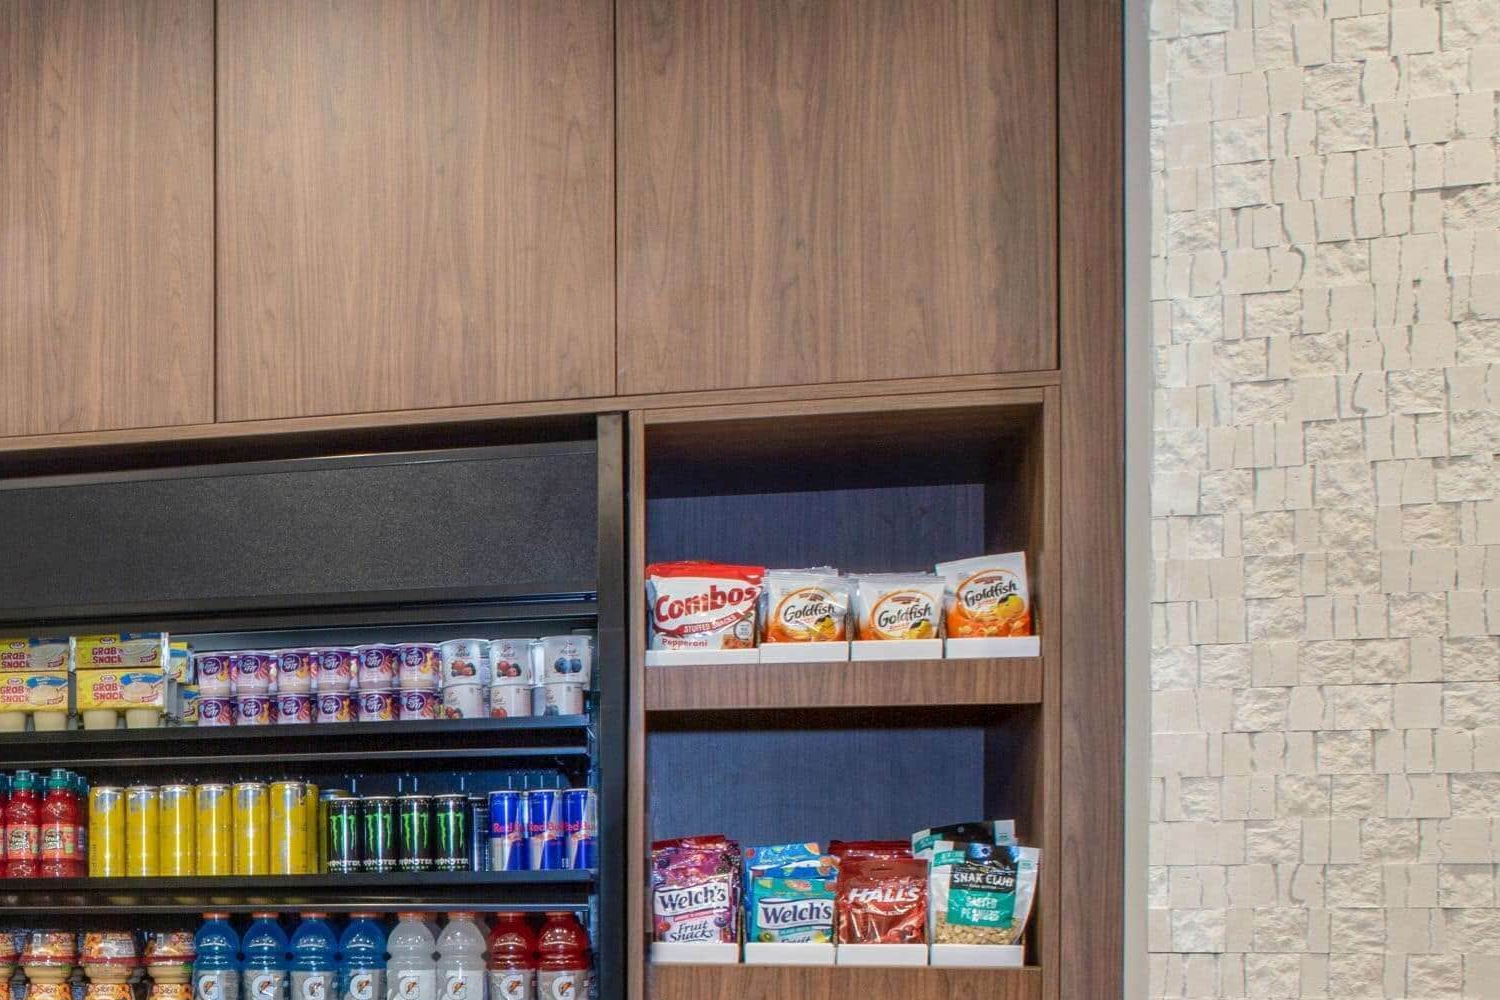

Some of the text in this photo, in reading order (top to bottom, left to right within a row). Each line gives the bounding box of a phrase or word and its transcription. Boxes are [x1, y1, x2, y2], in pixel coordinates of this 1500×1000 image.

[655, 585, 758, 623] Combos
[965, 580, 1018, 607] Goldfish
[784, 604, 836, 621] Goldfish
[878, 603, 932, 628] Goldfish
[661, 638, 708, 648] Pepperoni
[658, 886, 726, 911] Welch's
[849, 887, 920, 902] HALLS
[762, 903, 832, 924] Welch's
[670, 929, 714, 942] Snacks
[678, 920, 708, 932] Fruit
[350, 974, 372, 1000] G
[501, 974, 524, 1000] G
